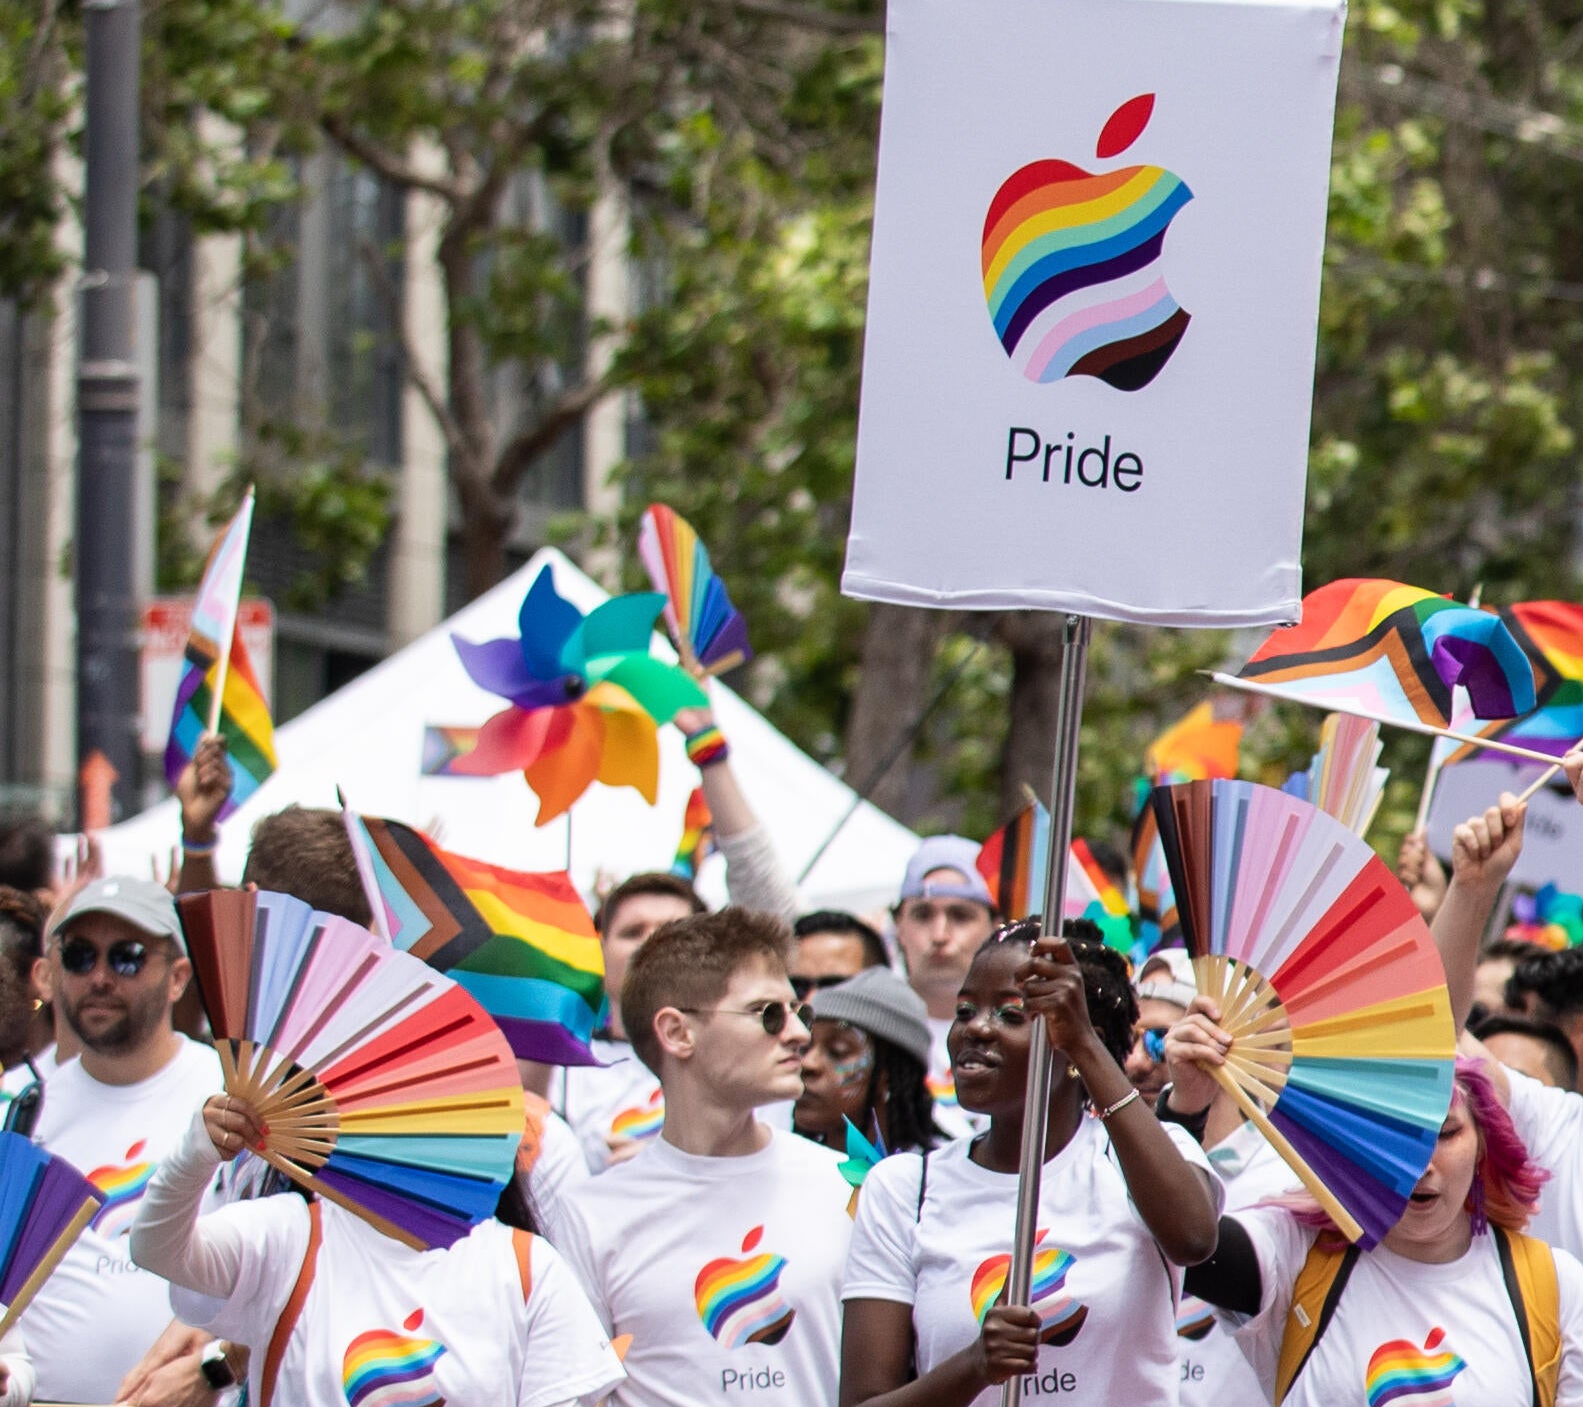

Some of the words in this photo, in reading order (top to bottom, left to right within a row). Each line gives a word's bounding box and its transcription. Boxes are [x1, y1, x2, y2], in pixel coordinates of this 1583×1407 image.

[1006, 428, 1143, 492] Pride
[722, 1366, 785, 1392] Pride
[1022, 1368, 1076, 1396] ride
